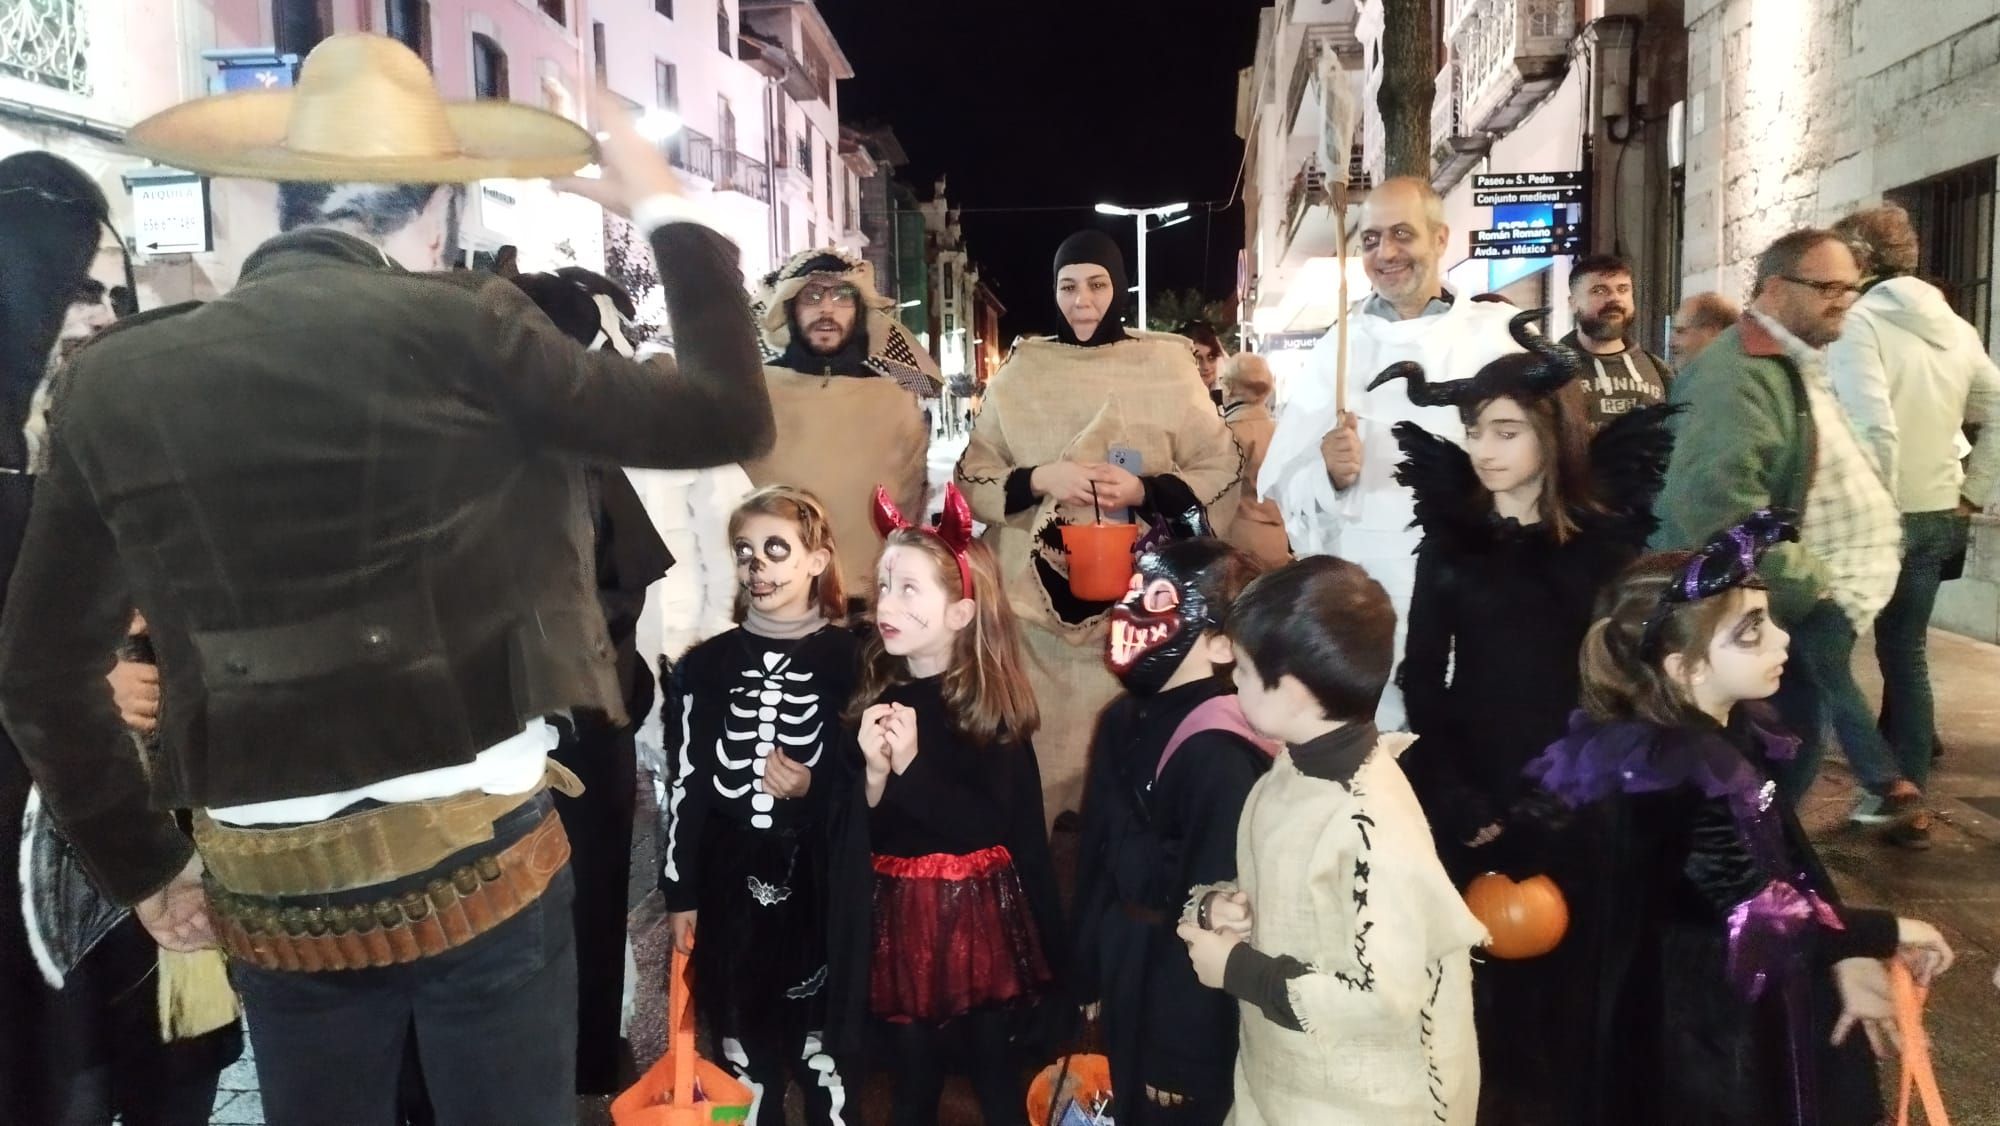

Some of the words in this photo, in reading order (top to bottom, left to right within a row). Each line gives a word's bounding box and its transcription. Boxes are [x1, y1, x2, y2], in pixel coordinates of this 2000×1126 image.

[1477, 175, 1505, 186] Paseo
[1516, 175, 1525, 184] S.
[1528, 174, 1555, 184] Pedro
[143, 189, 193, 200] ALQUILA
[1476, 193, 1518, 205] Conjunto
[1519, 191, 1560, 203] medieval
[1478, 230, 1511, 241] Román
[1512, 228, 1551, 239] Romano
[1474, 246, 1501, 257] Avda.
[1501, 248, 1511, 256] de
[1512, 244, 1546, 255] México
